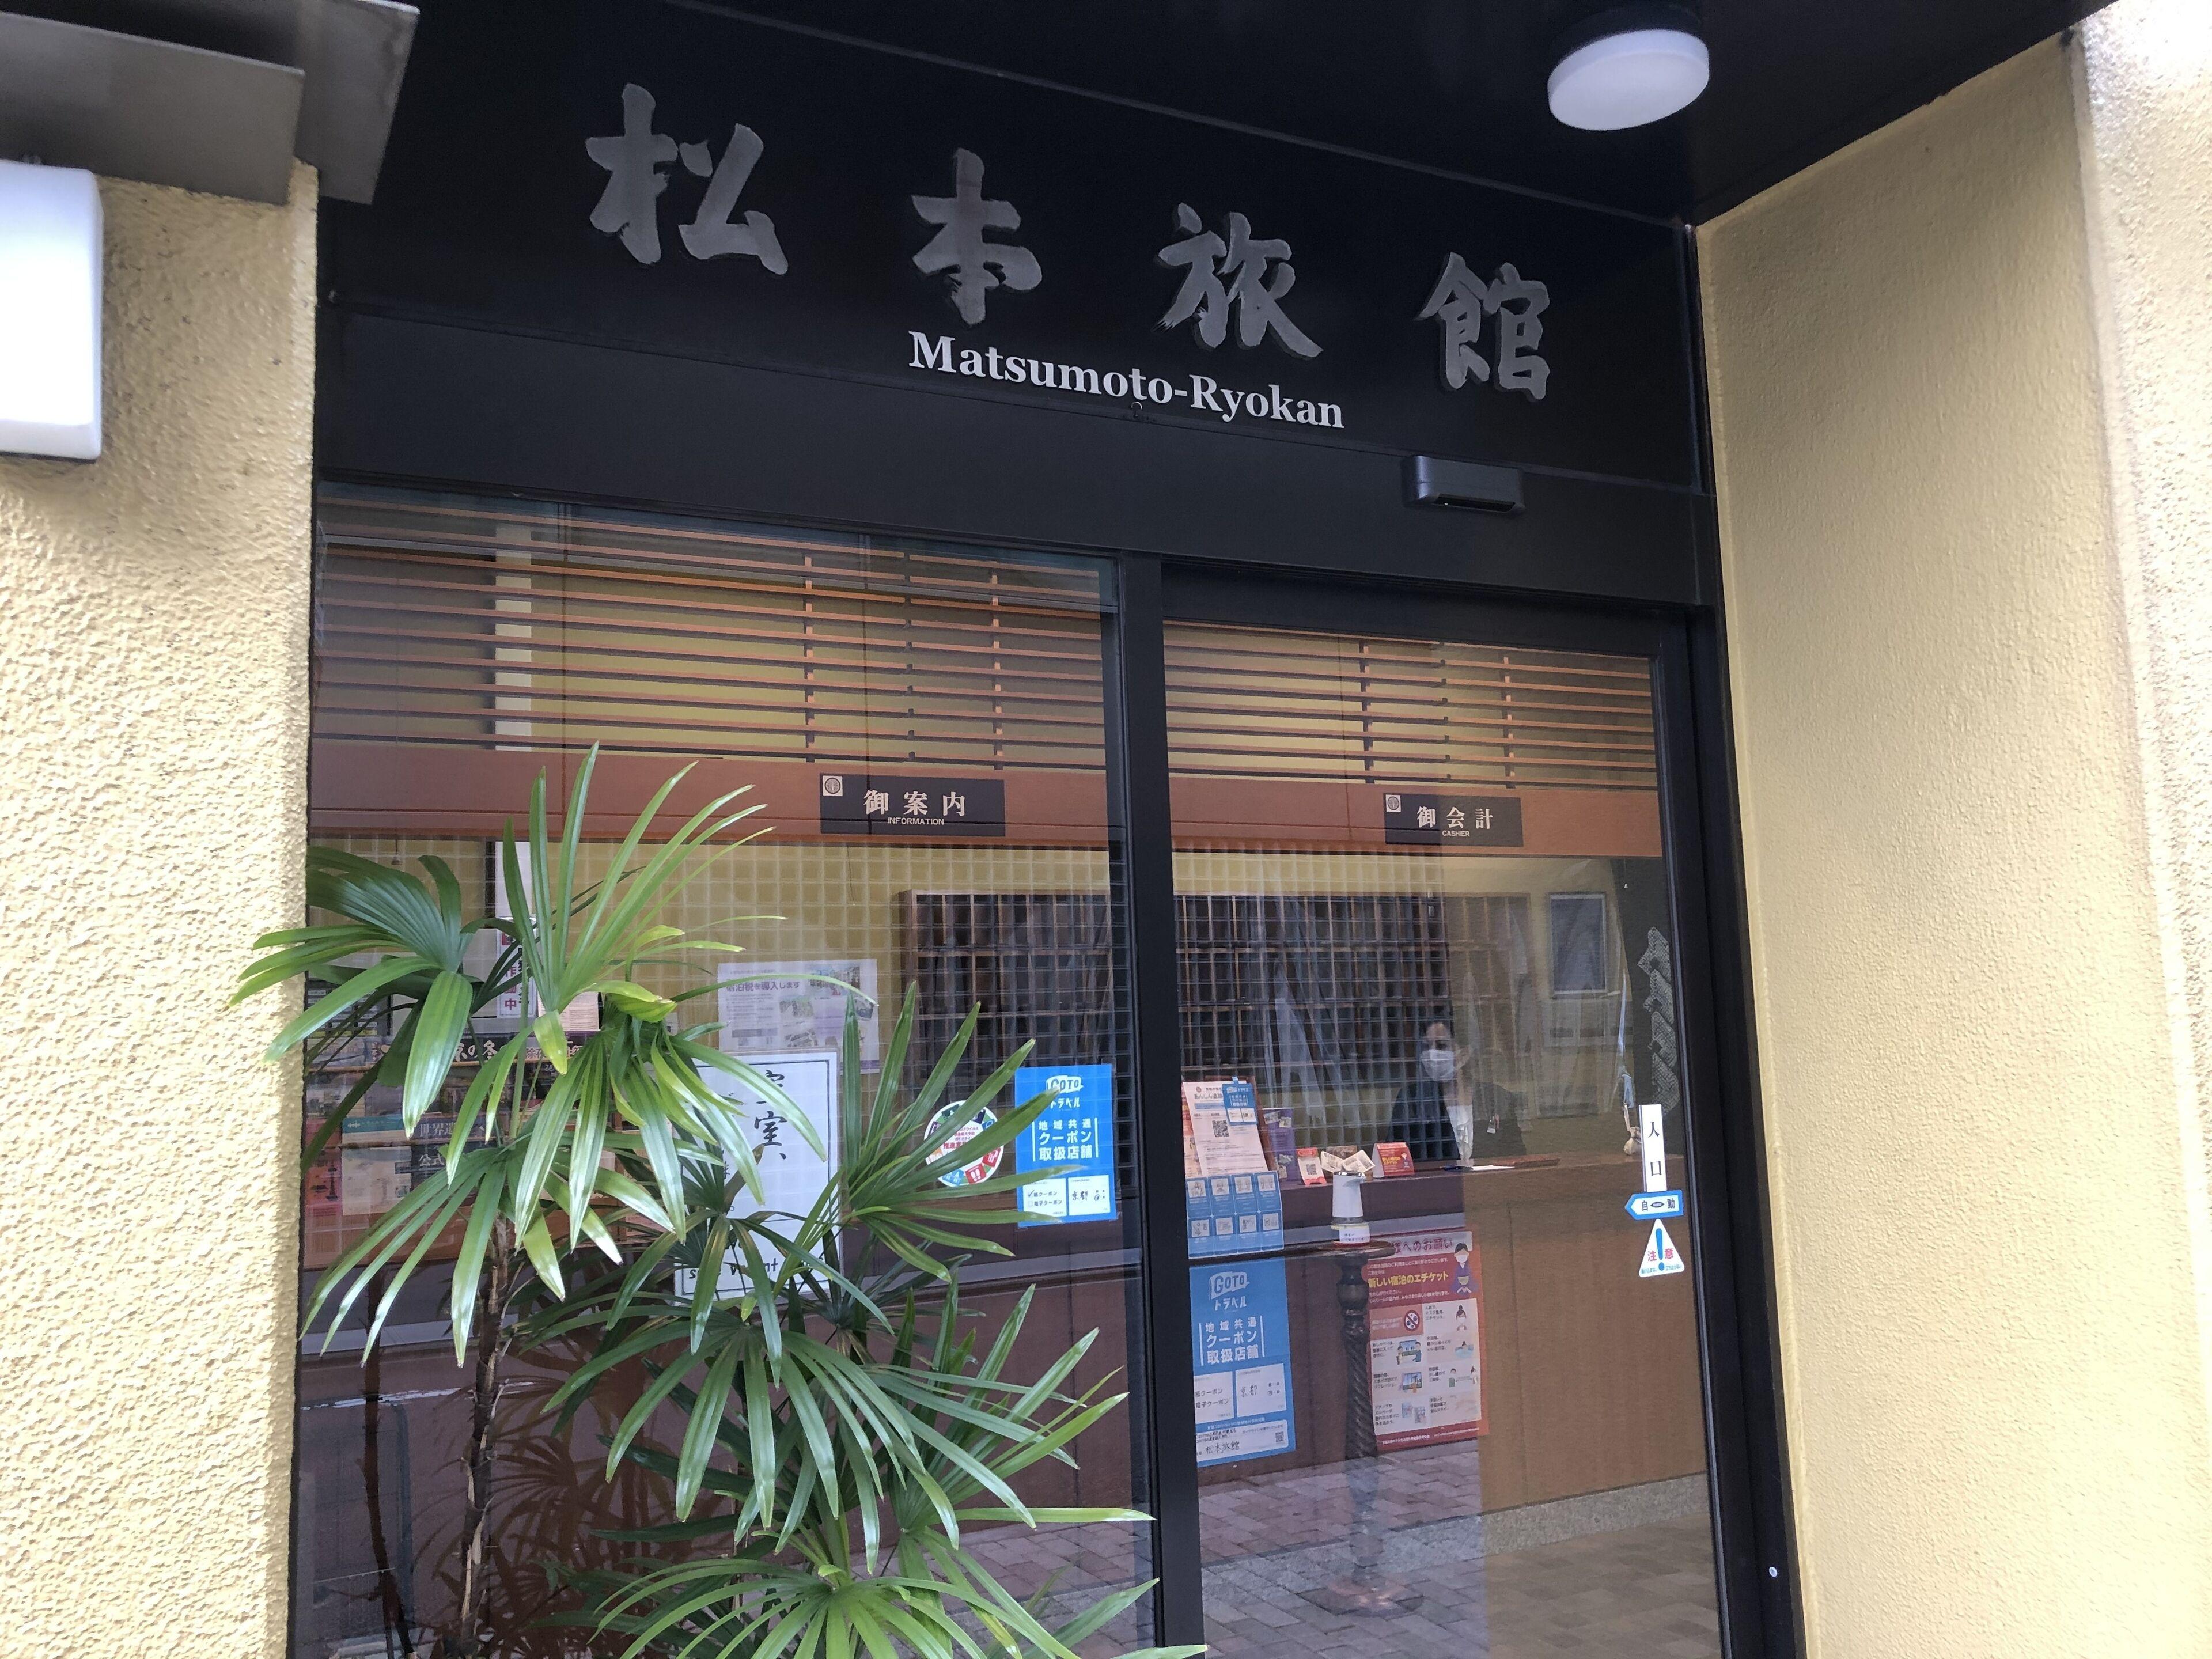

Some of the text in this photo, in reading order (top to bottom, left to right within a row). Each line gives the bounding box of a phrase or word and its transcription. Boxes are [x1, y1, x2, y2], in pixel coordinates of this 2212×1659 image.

[585, 82, 1551, 400] 松本旅館
[908, 330, 1345, 429] Matsumoto-Ryokan
[863, 789, 966, 816] 御案内
[887, 816, 945, 826] INFORMATION
[1416, 806, 1494, 830] 御会計
[1039, 1118, 1092, 1131] 地域共通
[1039, 1130, 1092, 1146] クーポン
[1039, 1144, 1093, 1161] 取扱店舗
[1647, 1120, 1663, 1176] 入口
[1642, 1198, 1676, 1211] 自動
[1647, 1248, 1674, 1262] 注意
[1214, 1275, 1245, 1294] GOTO
[1215, 1296, 1247, 1311] トラベル
[1205, 1316, 1257, 1332] 地域共通
[1206, 1330, 1257, 1349] クーポン
[1207, 1344, 1259, 1365] 取扱店舗
[1240, 1384, 1258, 1398] 京都
